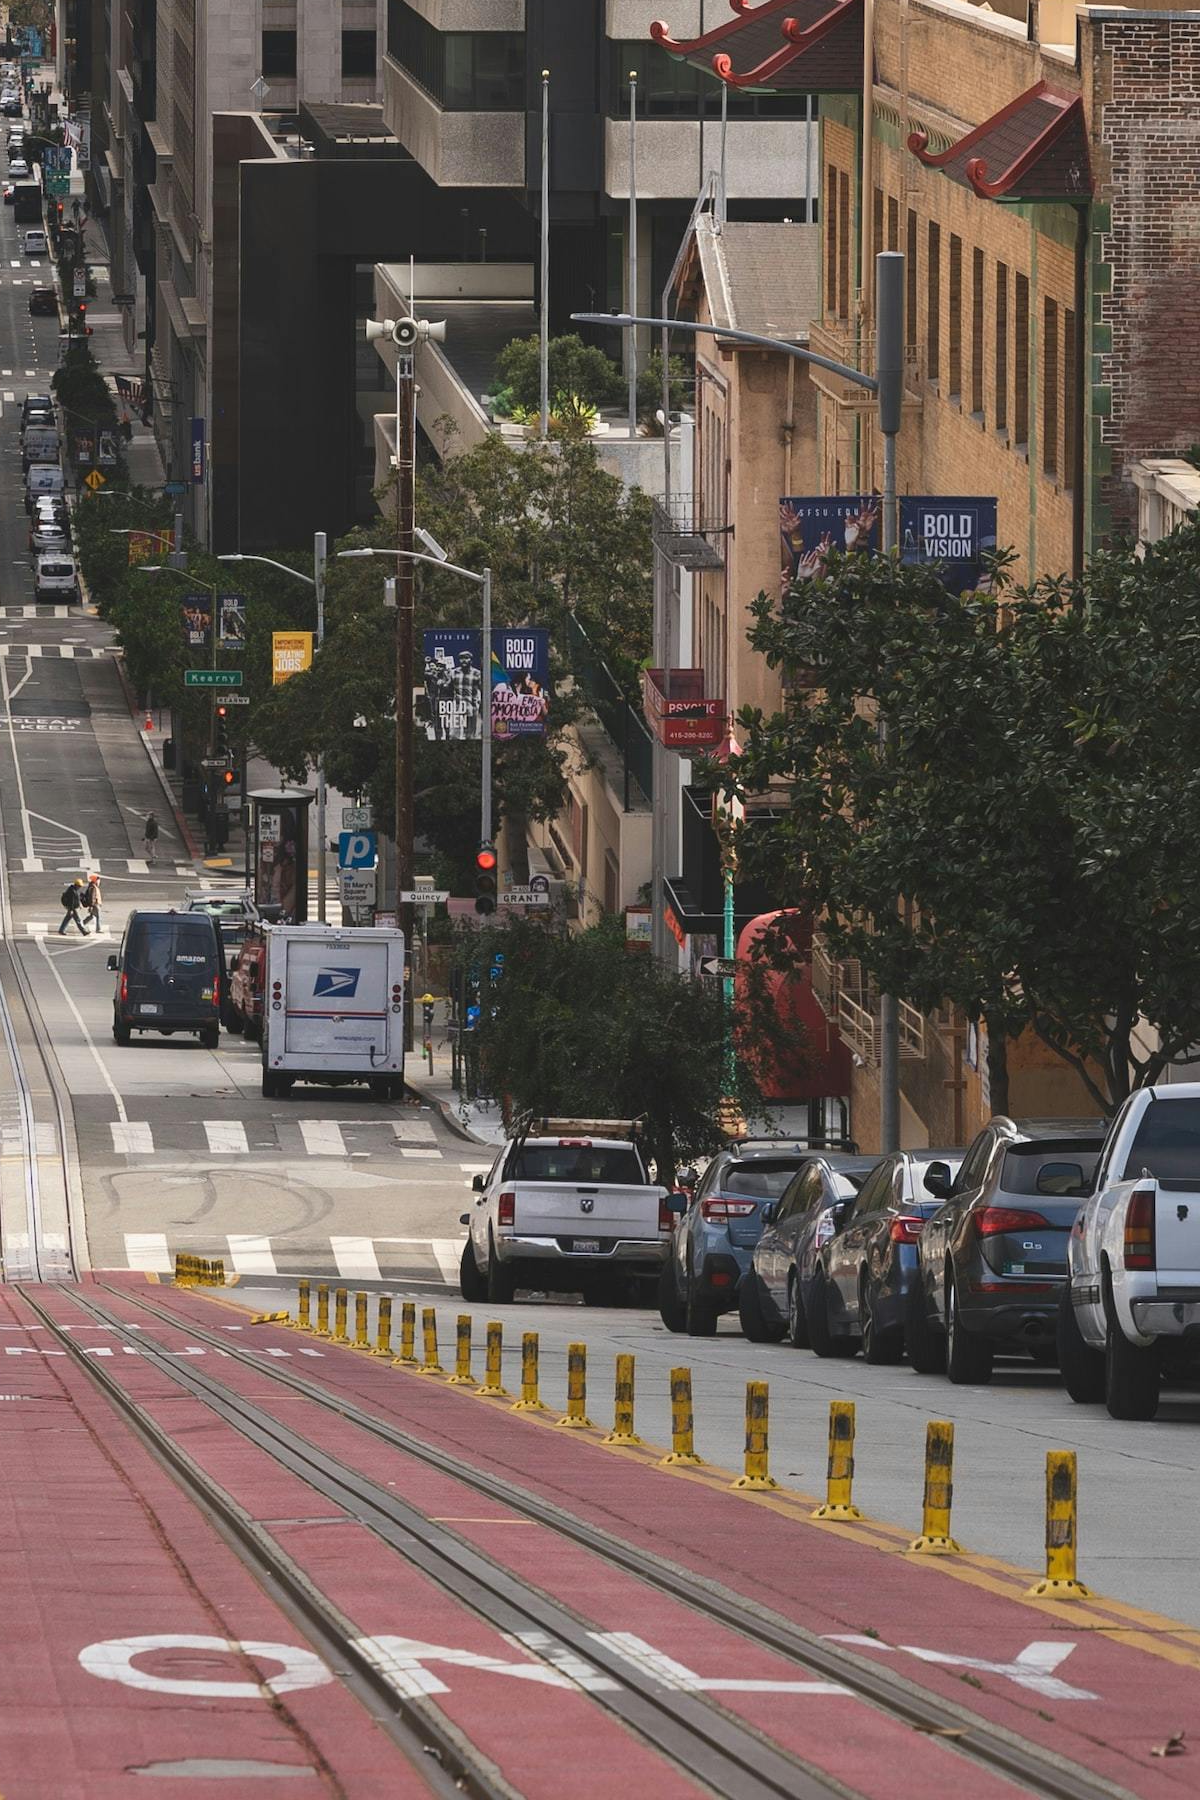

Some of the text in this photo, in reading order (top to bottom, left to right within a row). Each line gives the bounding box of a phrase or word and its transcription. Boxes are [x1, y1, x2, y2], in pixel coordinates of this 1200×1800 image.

[800, 508, 859, 517] SFSU.EDU
[923, 514, 972, 538] BOLD
[925, 539, 972, 558] VISION
[506, 639, 534, 653] BOLD
[506, 653, 533, 669] NOW
[191, 673, 236, 684] Kearny
[439, 700, 467, 714] BOLD
[439, 714, 468, 729] THEN
[410, 893, 441, 902] Quincy
[503, 894, 541, 903] GRANT
[176, 955, 206, 963] amazon
[76, 1631, 1102, 1701] ONLY
